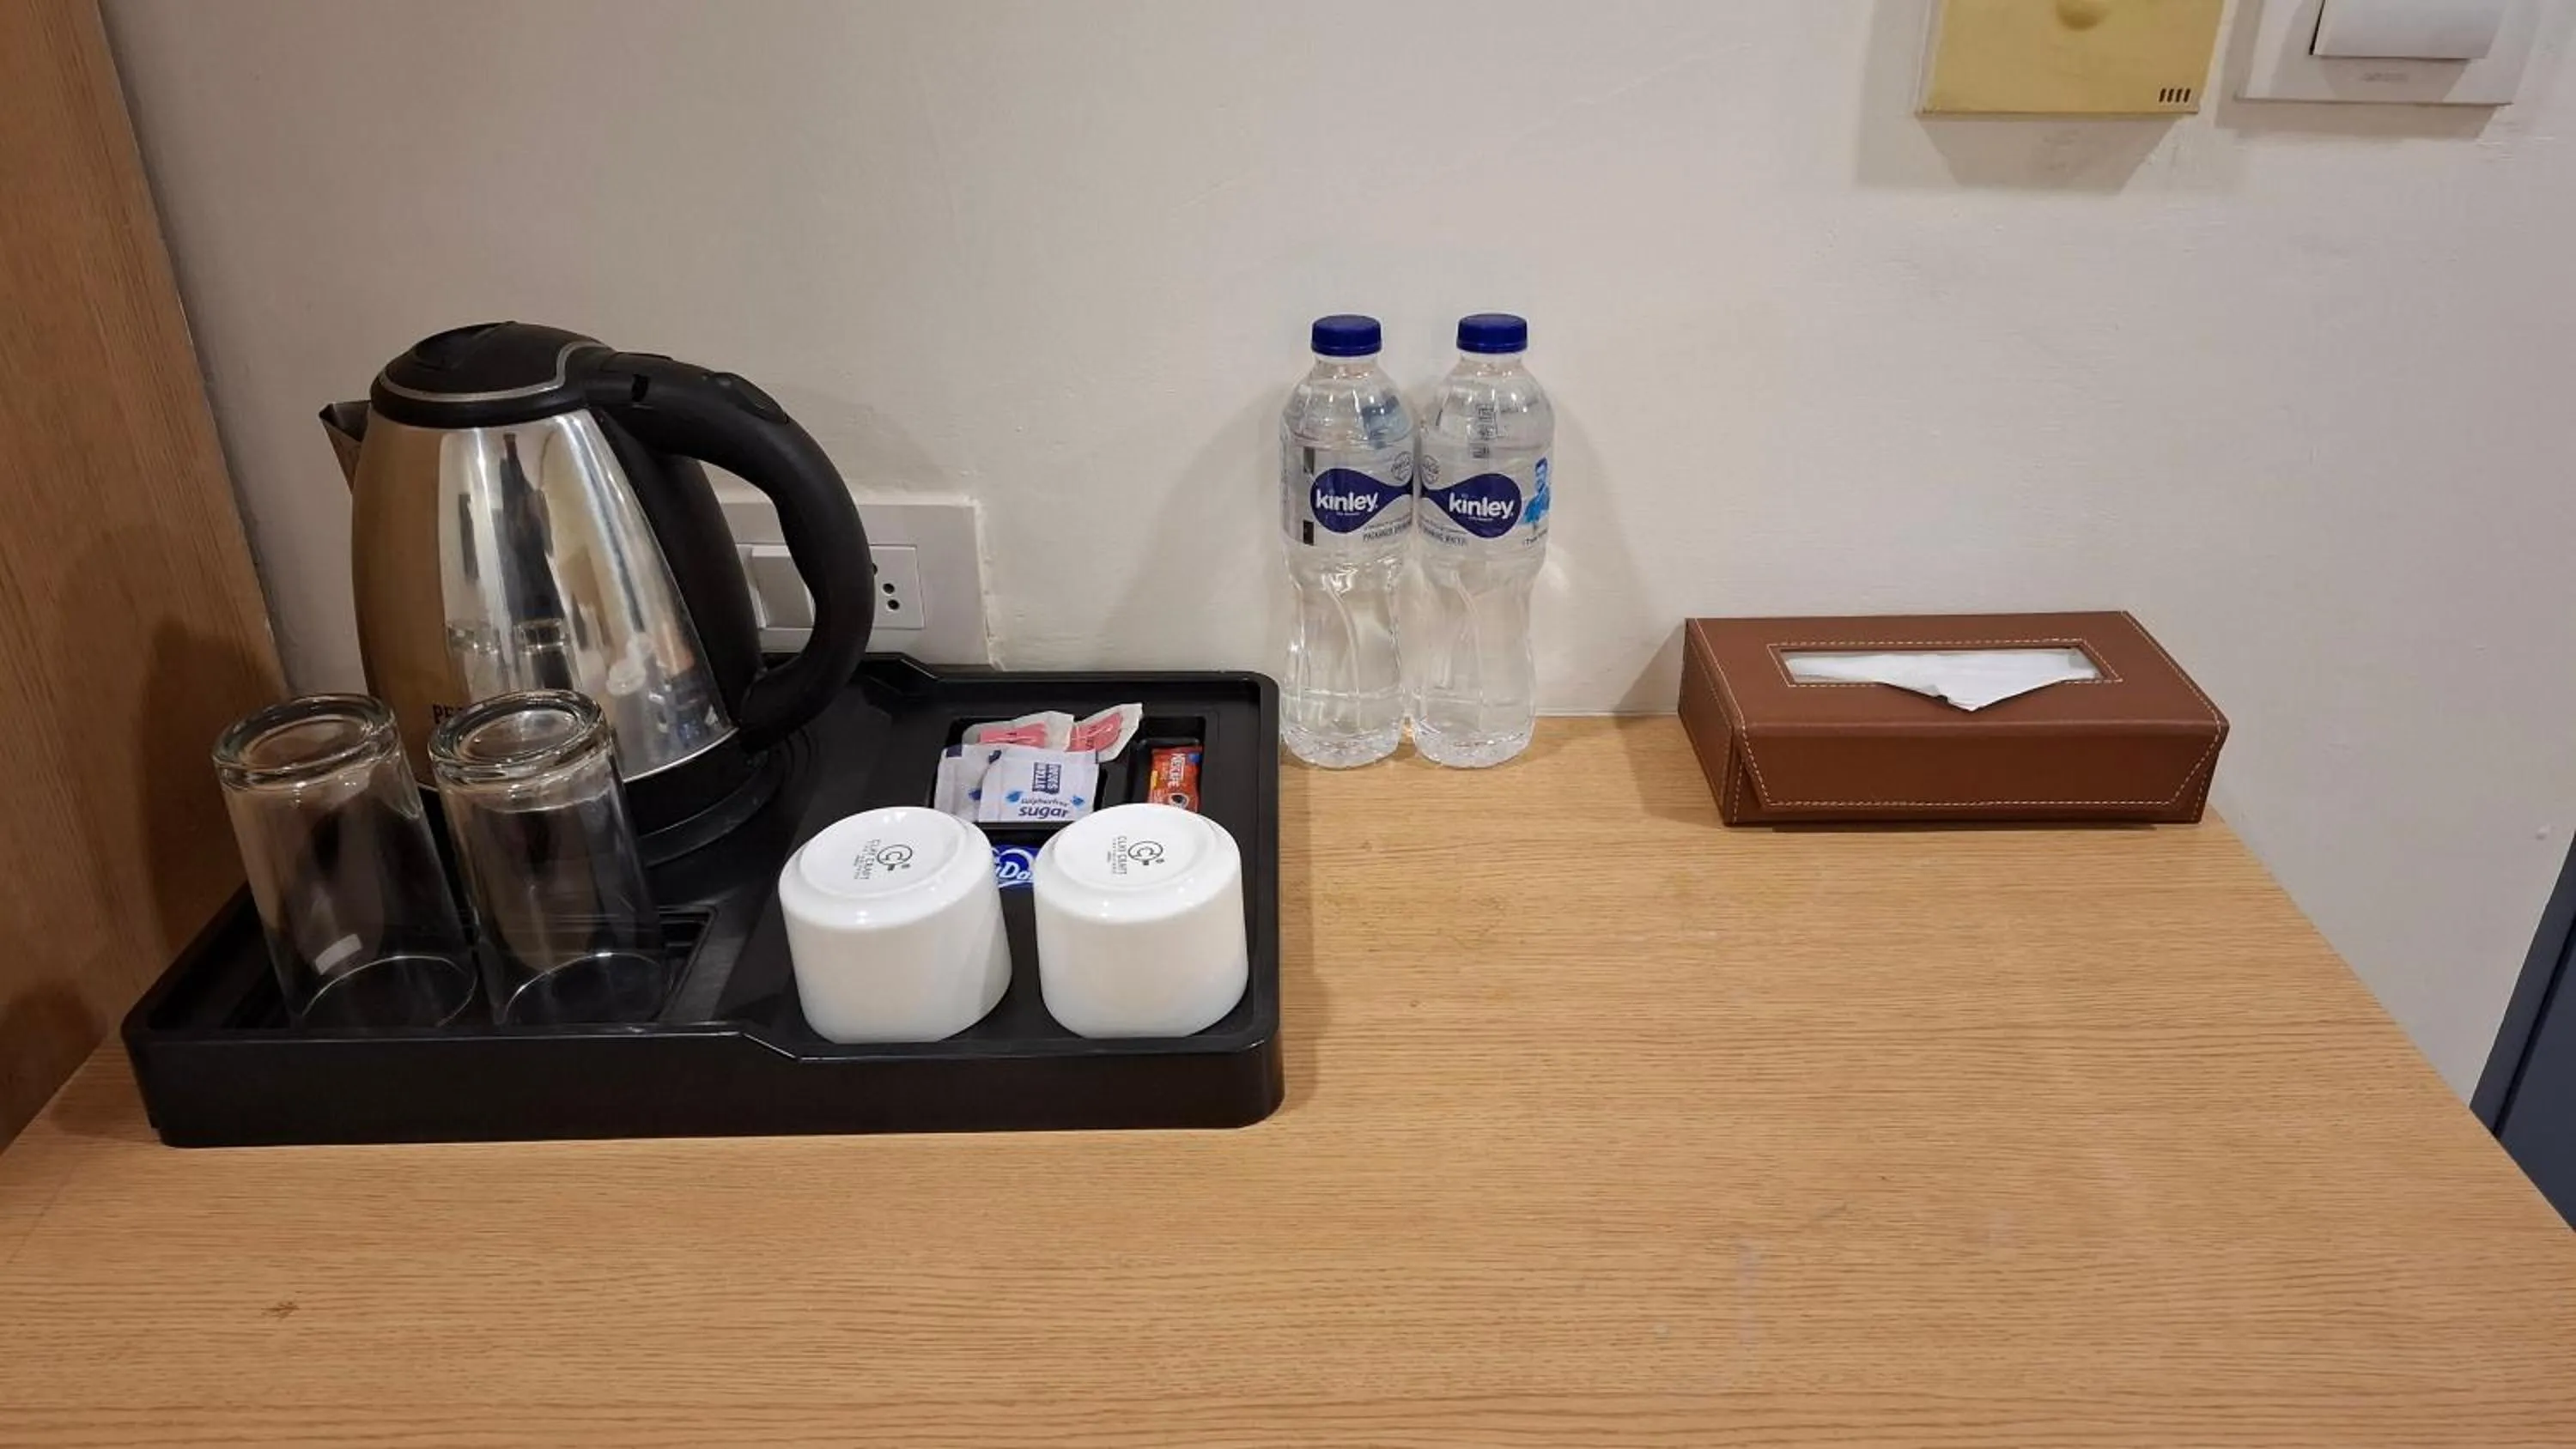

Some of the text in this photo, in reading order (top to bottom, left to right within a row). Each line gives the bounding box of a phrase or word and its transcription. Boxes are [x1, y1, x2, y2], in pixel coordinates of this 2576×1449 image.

[1315, 488, 1379, 512] kinley
[1449, 492, 1515, 519] kinley
[1018, 806, 1069, 820] sugar
